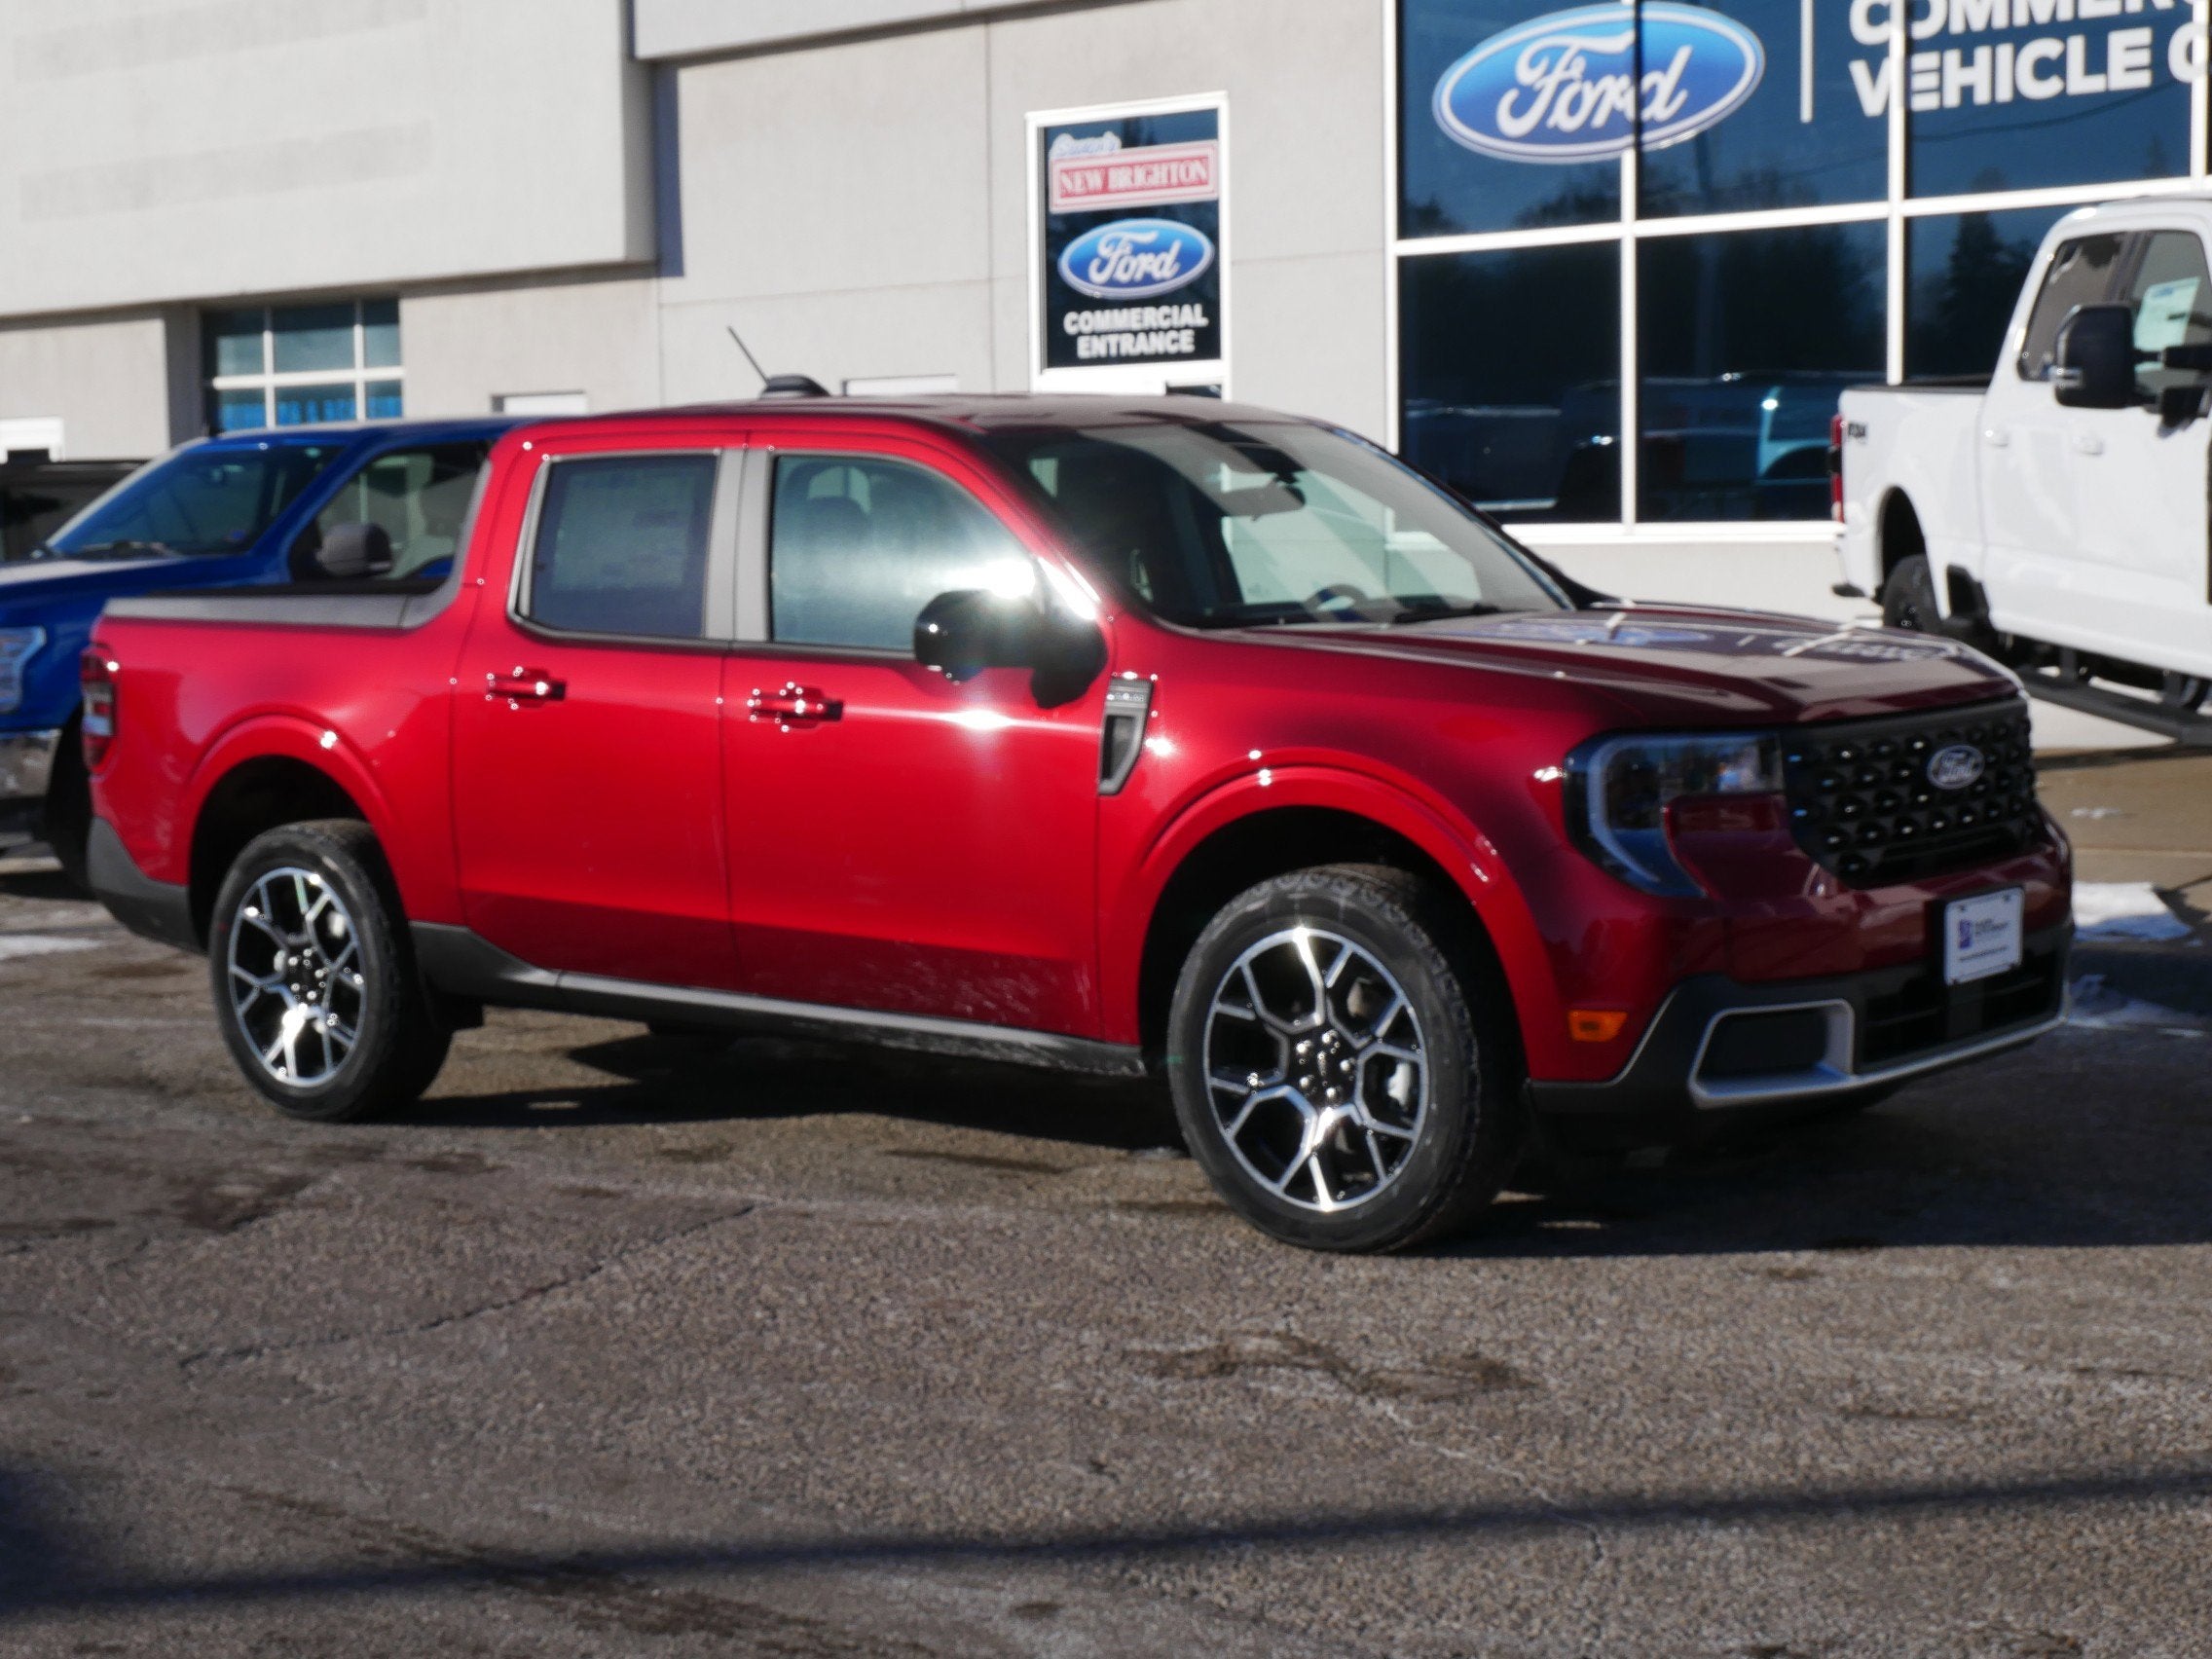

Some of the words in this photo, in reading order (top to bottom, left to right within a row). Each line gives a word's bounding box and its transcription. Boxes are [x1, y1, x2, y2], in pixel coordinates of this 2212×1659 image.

[1496, 29, 1692, 138] Ford
[1849, 26, 2153, 117] VEHICLE
[1060, 168, 1105, 195] NEW
[1108, 158, 1208, 193] BRIGHTON
[1088, 231, 1181, 284] Ford
[1063, 303, 1209, 335] COMMERCIAL
[1077, 329, 1196, 359] ENTRANCE
